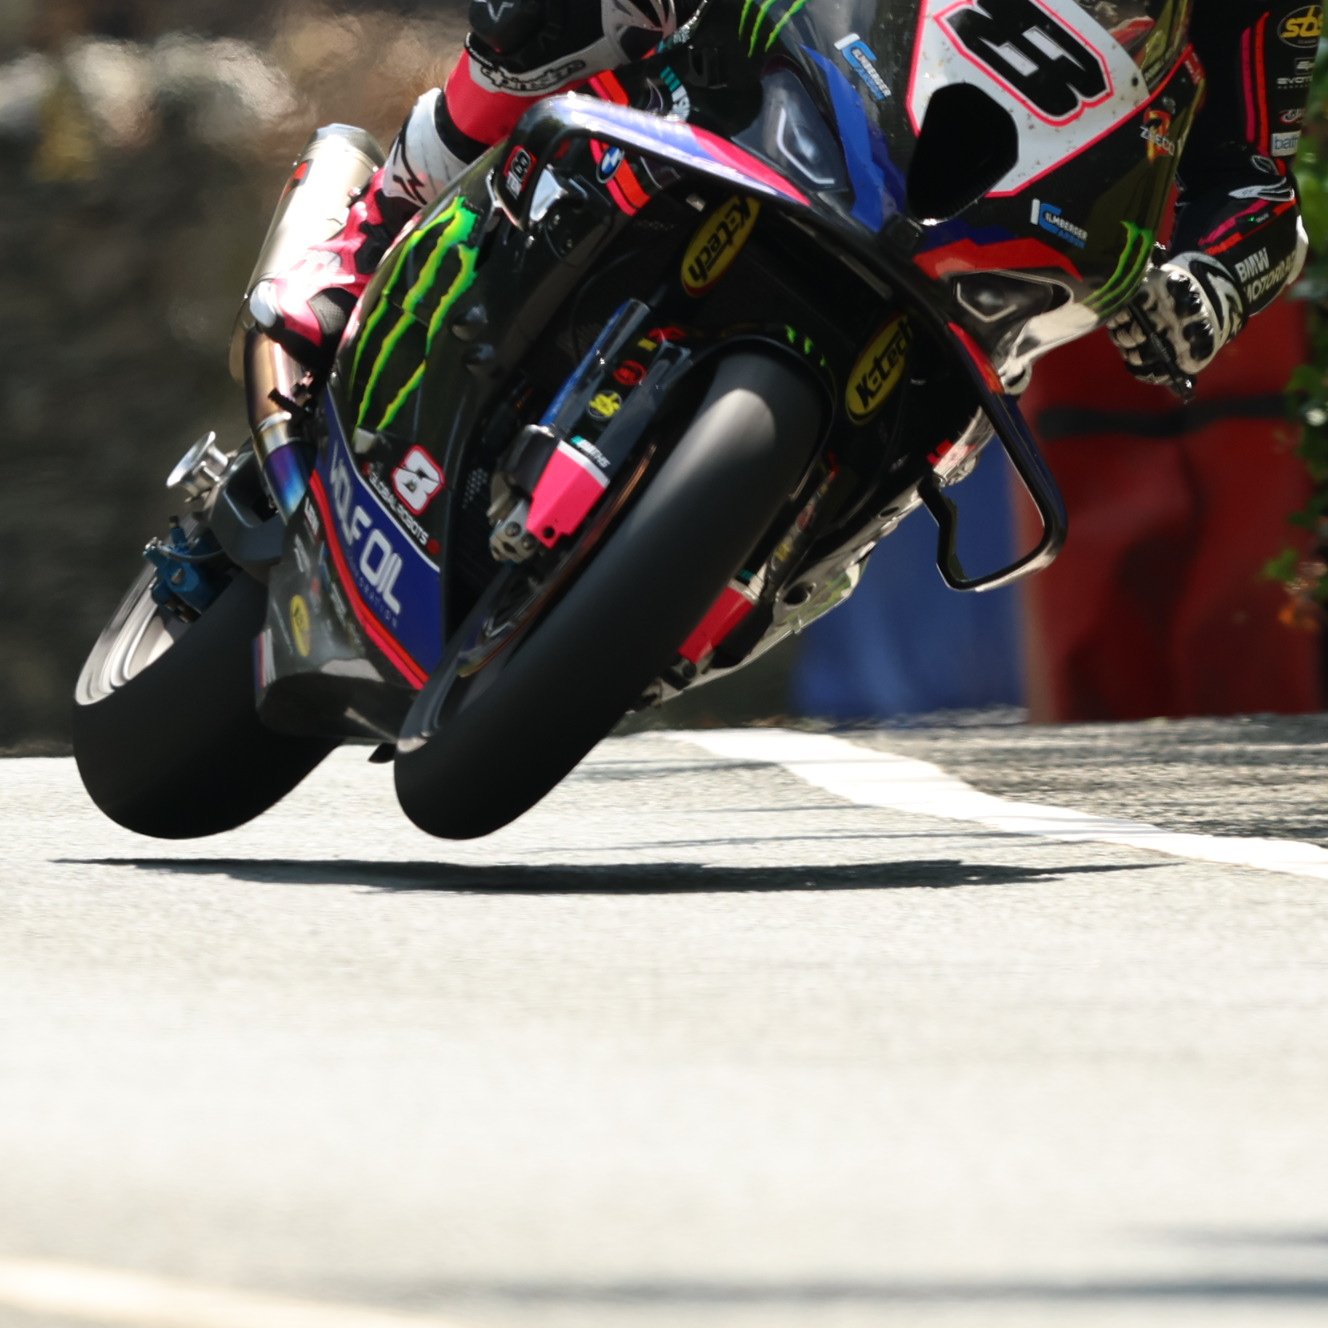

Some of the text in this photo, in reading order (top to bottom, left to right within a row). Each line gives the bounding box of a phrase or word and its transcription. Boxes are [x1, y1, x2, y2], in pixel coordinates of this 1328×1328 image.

[1234, 246, 1270, 283] BMW
[392, 446, 443, 512] 8
[330, 441, 403, 616] WOLF OIL
